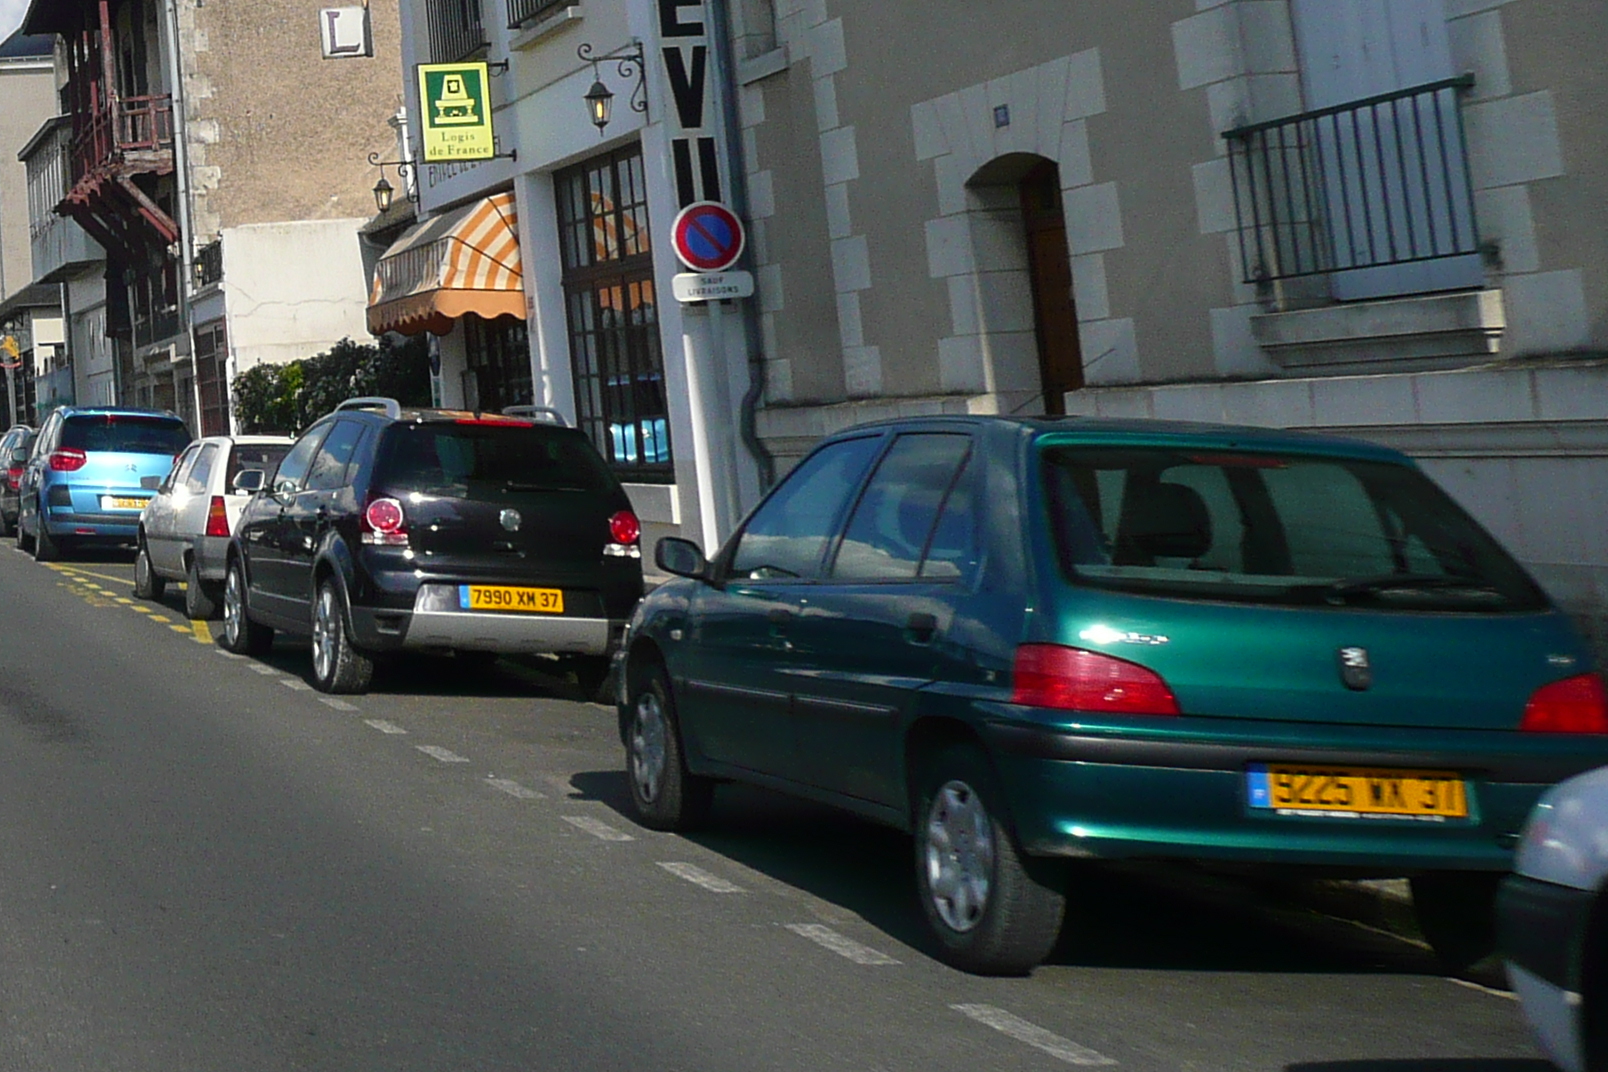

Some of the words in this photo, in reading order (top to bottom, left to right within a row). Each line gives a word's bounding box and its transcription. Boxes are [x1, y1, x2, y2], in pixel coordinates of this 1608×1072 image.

[441, 131, 475, 143] Logis
[429, 145, 444, 156] de
[447, 144, 490, 156] France
[700, 276, 724, 286] SAUF
[687, 285, 739, 296] LIVRAISONS
[472, 589, 512, 605] 7990
[516, 591, 536, 607] XM
[540, 592, 559, 608] 37
